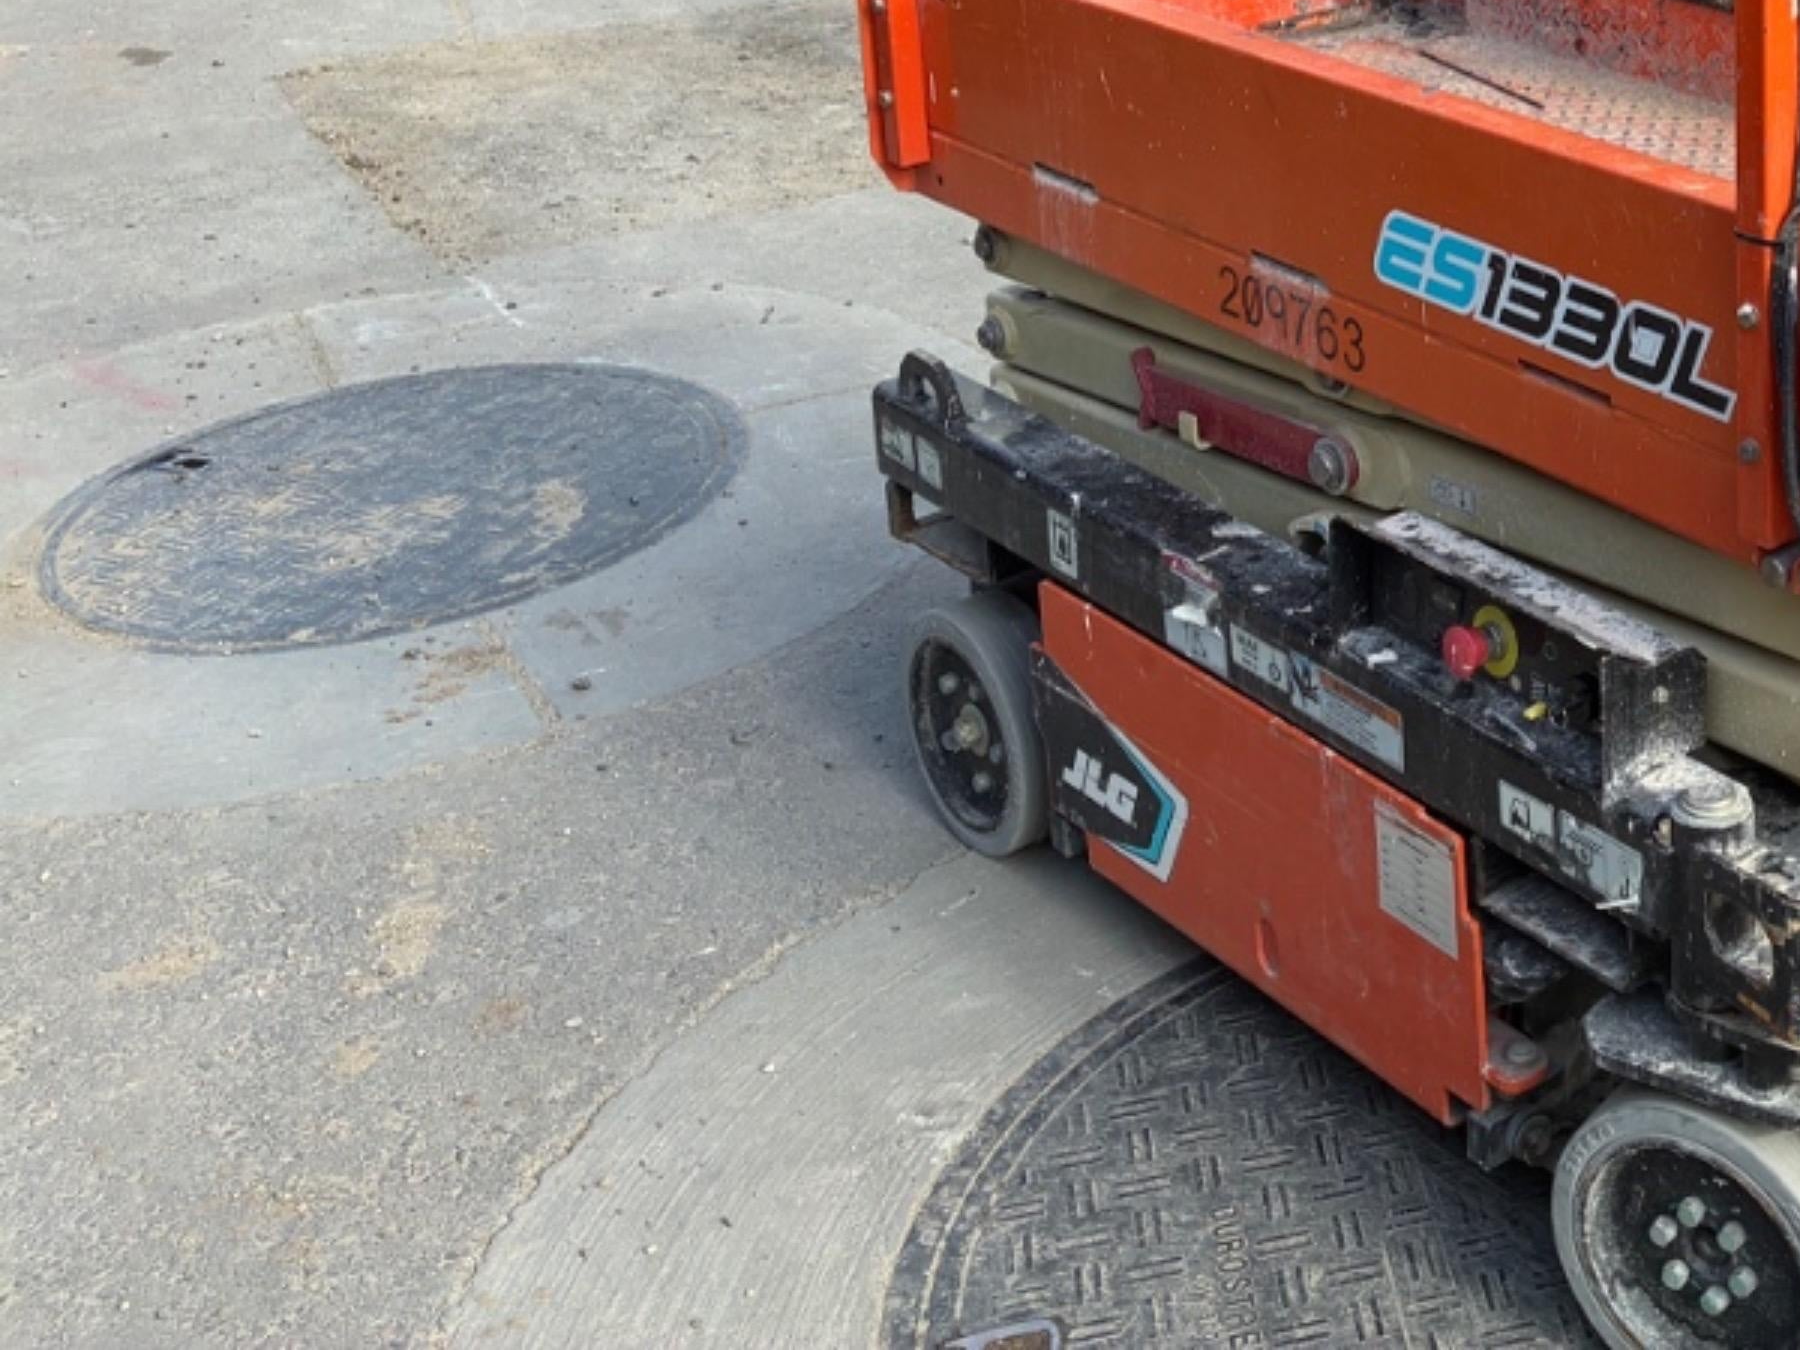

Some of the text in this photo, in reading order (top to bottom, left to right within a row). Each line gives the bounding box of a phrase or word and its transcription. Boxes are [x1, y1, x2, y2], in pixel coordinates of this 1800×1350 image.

[1218, 265, 1366, 373] 209763
[1374, 210, 1737, 422] ES1330L
[1061, 748, 1138, 824] JLG
